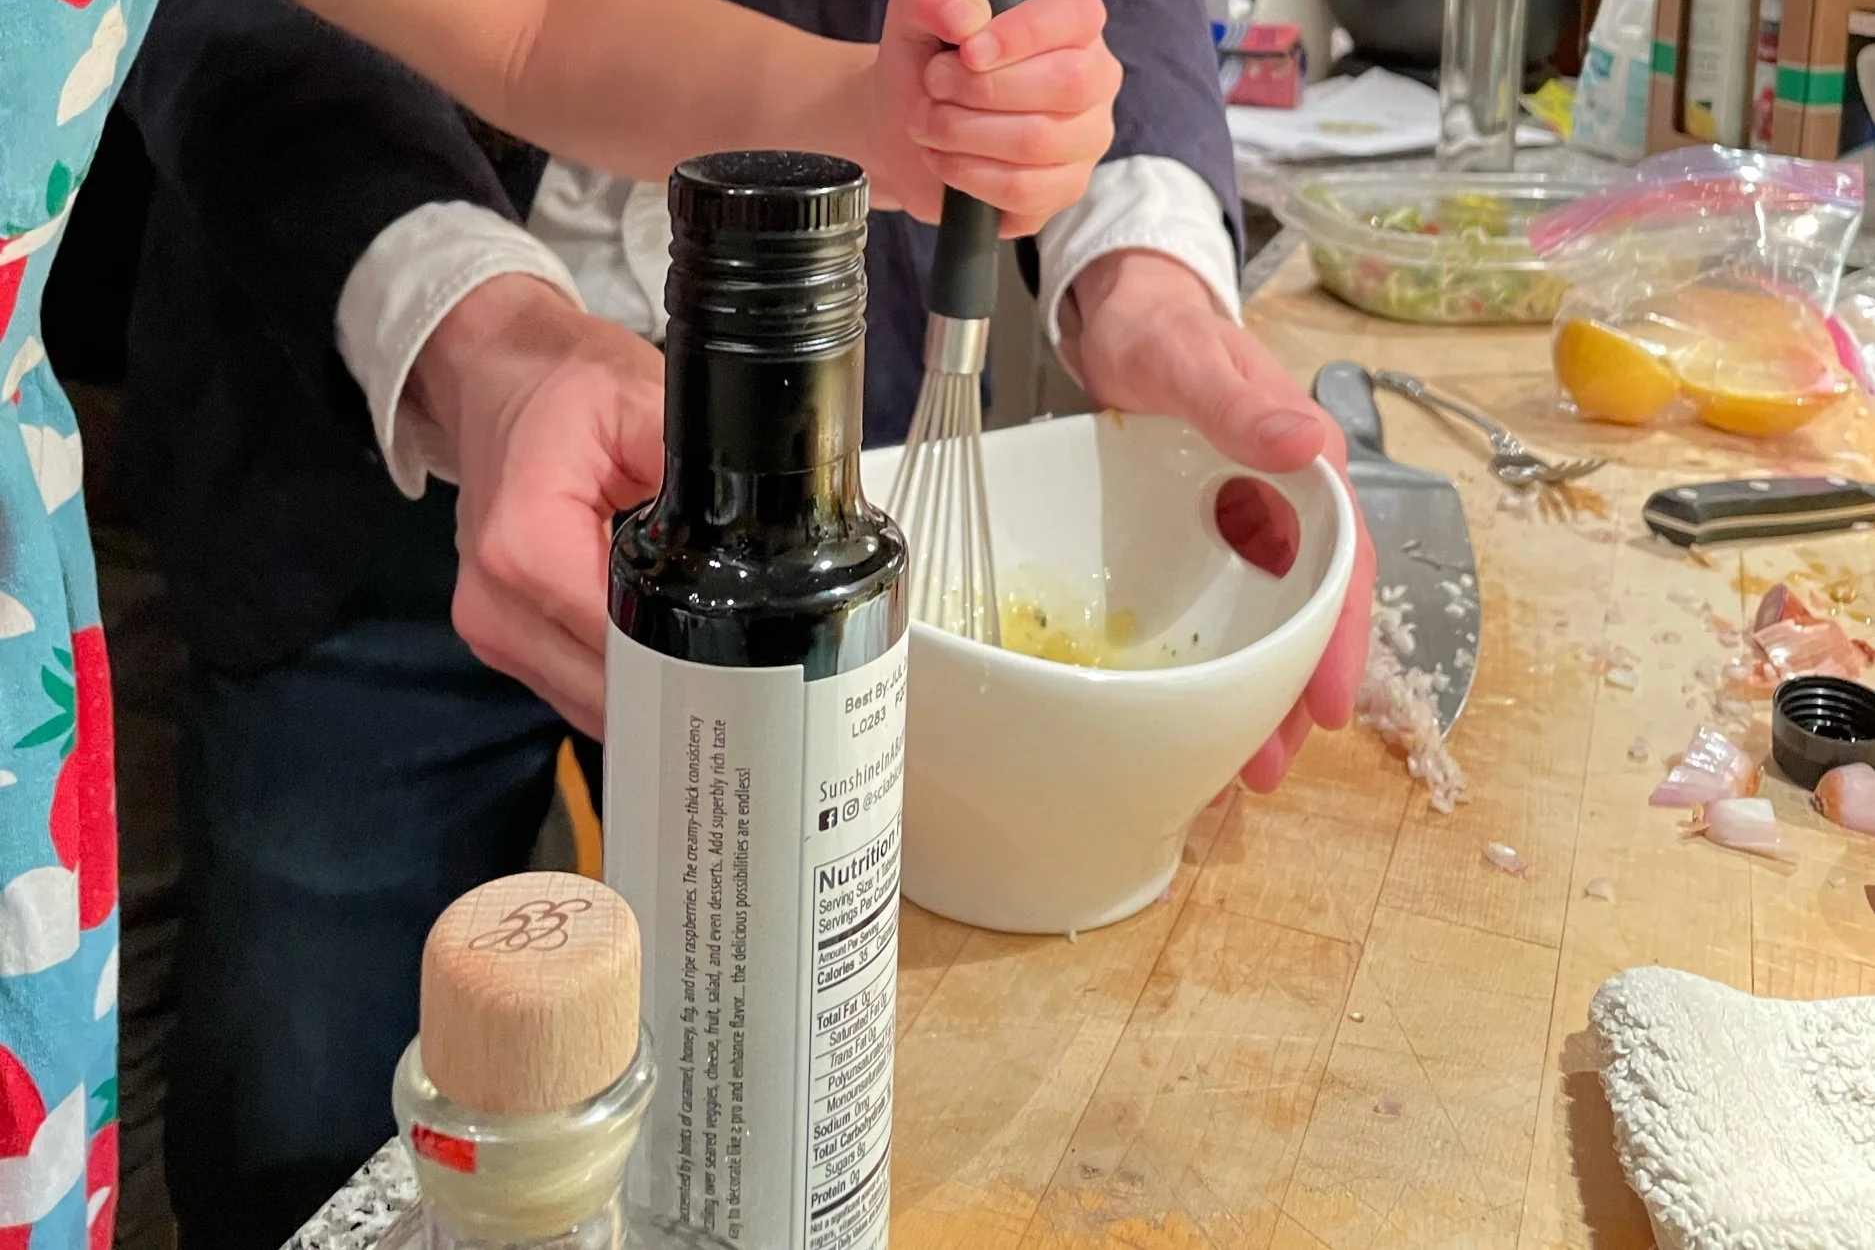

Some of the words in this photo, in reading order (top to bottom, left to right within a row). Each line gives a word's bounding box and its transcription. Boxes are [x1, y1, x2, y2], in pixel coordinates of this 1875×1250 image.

[845, 688, 872, 714] Best
[712, 719, 726, 748] taste
[686, 714, 704, 783] consistency
[710, 752, 725, 774] rich
[709, 778, 728, 828] superbly
[734, 767, 750, 815] endless!
[738, 818, 750, 836] are
[708, 831, 723, 855] Add
[682, 864, 697, 883] The
[733, 840, 751, 907] possibilities
[819, 829, 895, 894] Nutrition
[818, 907, 858, 934] Servings
[860, 896, 873, 914] Per
[819, 890, 854, 915] Serving
[710, 914, 722, 941] even
[731, 912, 747, 961] delicious
[706, 944, 720, 966] and
[818, 944, 846, 965] Amount
[848, 938, 858, 951] Per
[682, 955, 698, 978] ripe
[730, 965, 746, 983] the
[818, 959, 854, 986] Calories
[859, 947, 868, 965] 35
[682, 978, 694, 1002] and
[817, 1007, 841, 1030] Total
[844, 999, 858, 1018] Fat
[830, 1009, 868, 1047] Saturated
[870, 1000, 880, 1020] Fat
[729, 1031, 744, 1078] enhance
[830, 1046, 854, 1069] Trans
[855, 1033, 867, 1054] Fat
[728, 1082, 743, 1102] and
[814, 1112, 850, 1140] Sodium
[702, 1132, 716, 1169] seared
[814, 1138, 837, 1162] Total
[825, 1150, 855, 1178] Sugars
[811, 1180, 846, 1208] Protein
[850, 1168, 860, 1186] 0g
